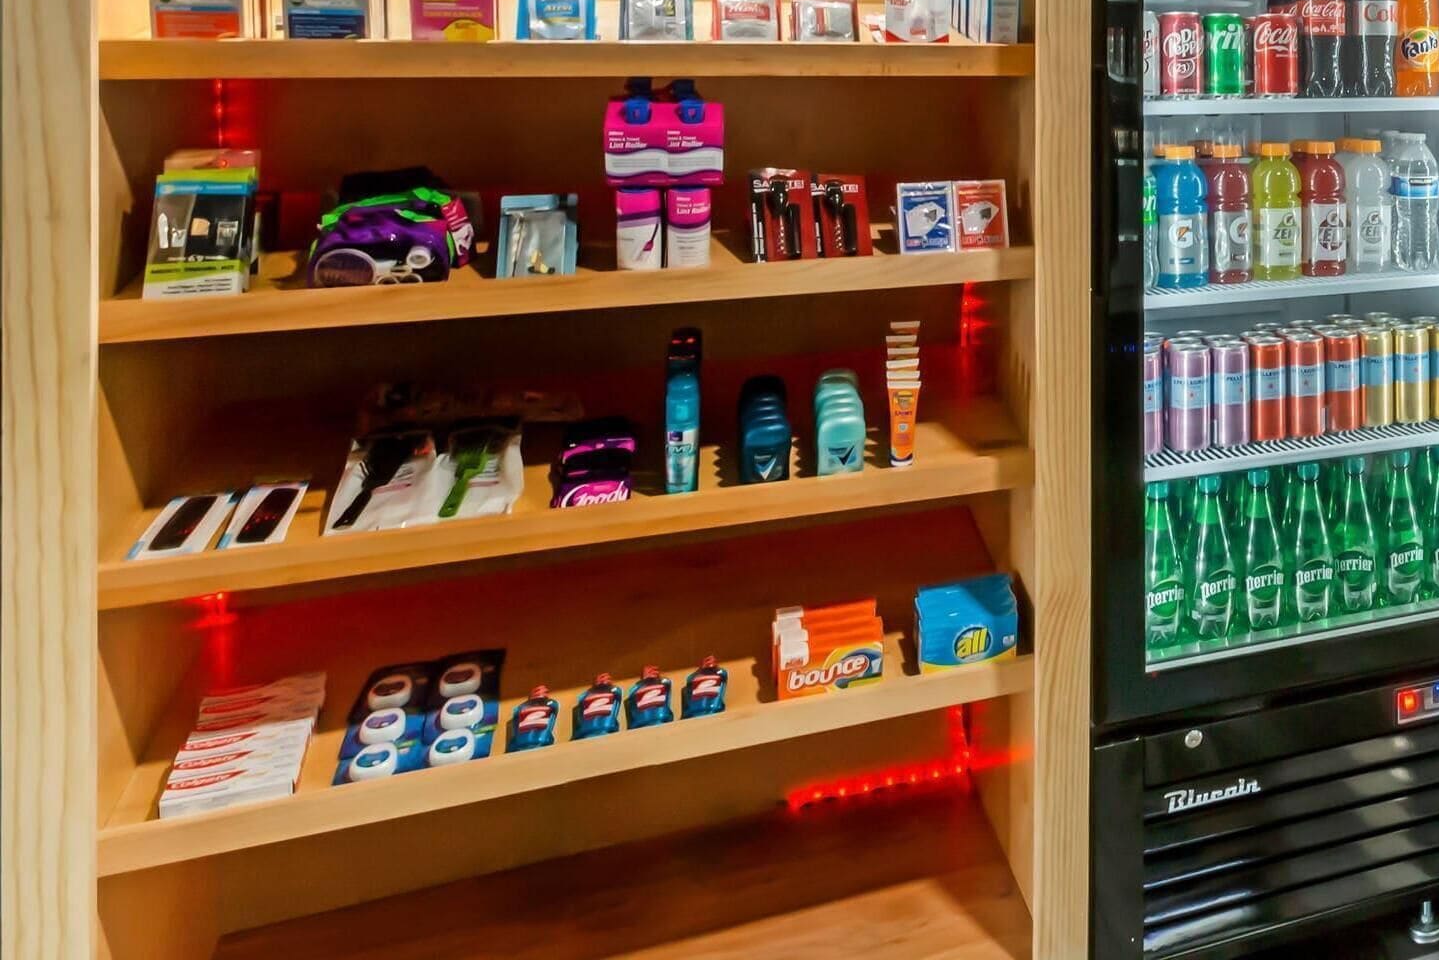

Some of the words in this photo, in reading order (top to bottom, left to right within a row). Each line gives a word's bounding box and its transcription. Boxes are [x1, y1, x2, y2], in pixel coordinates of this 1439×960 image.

[1400, 36, 1439, 60] Fanta
[956, 627, 989, 659] all
[788, 653, 867, 690] bounce
